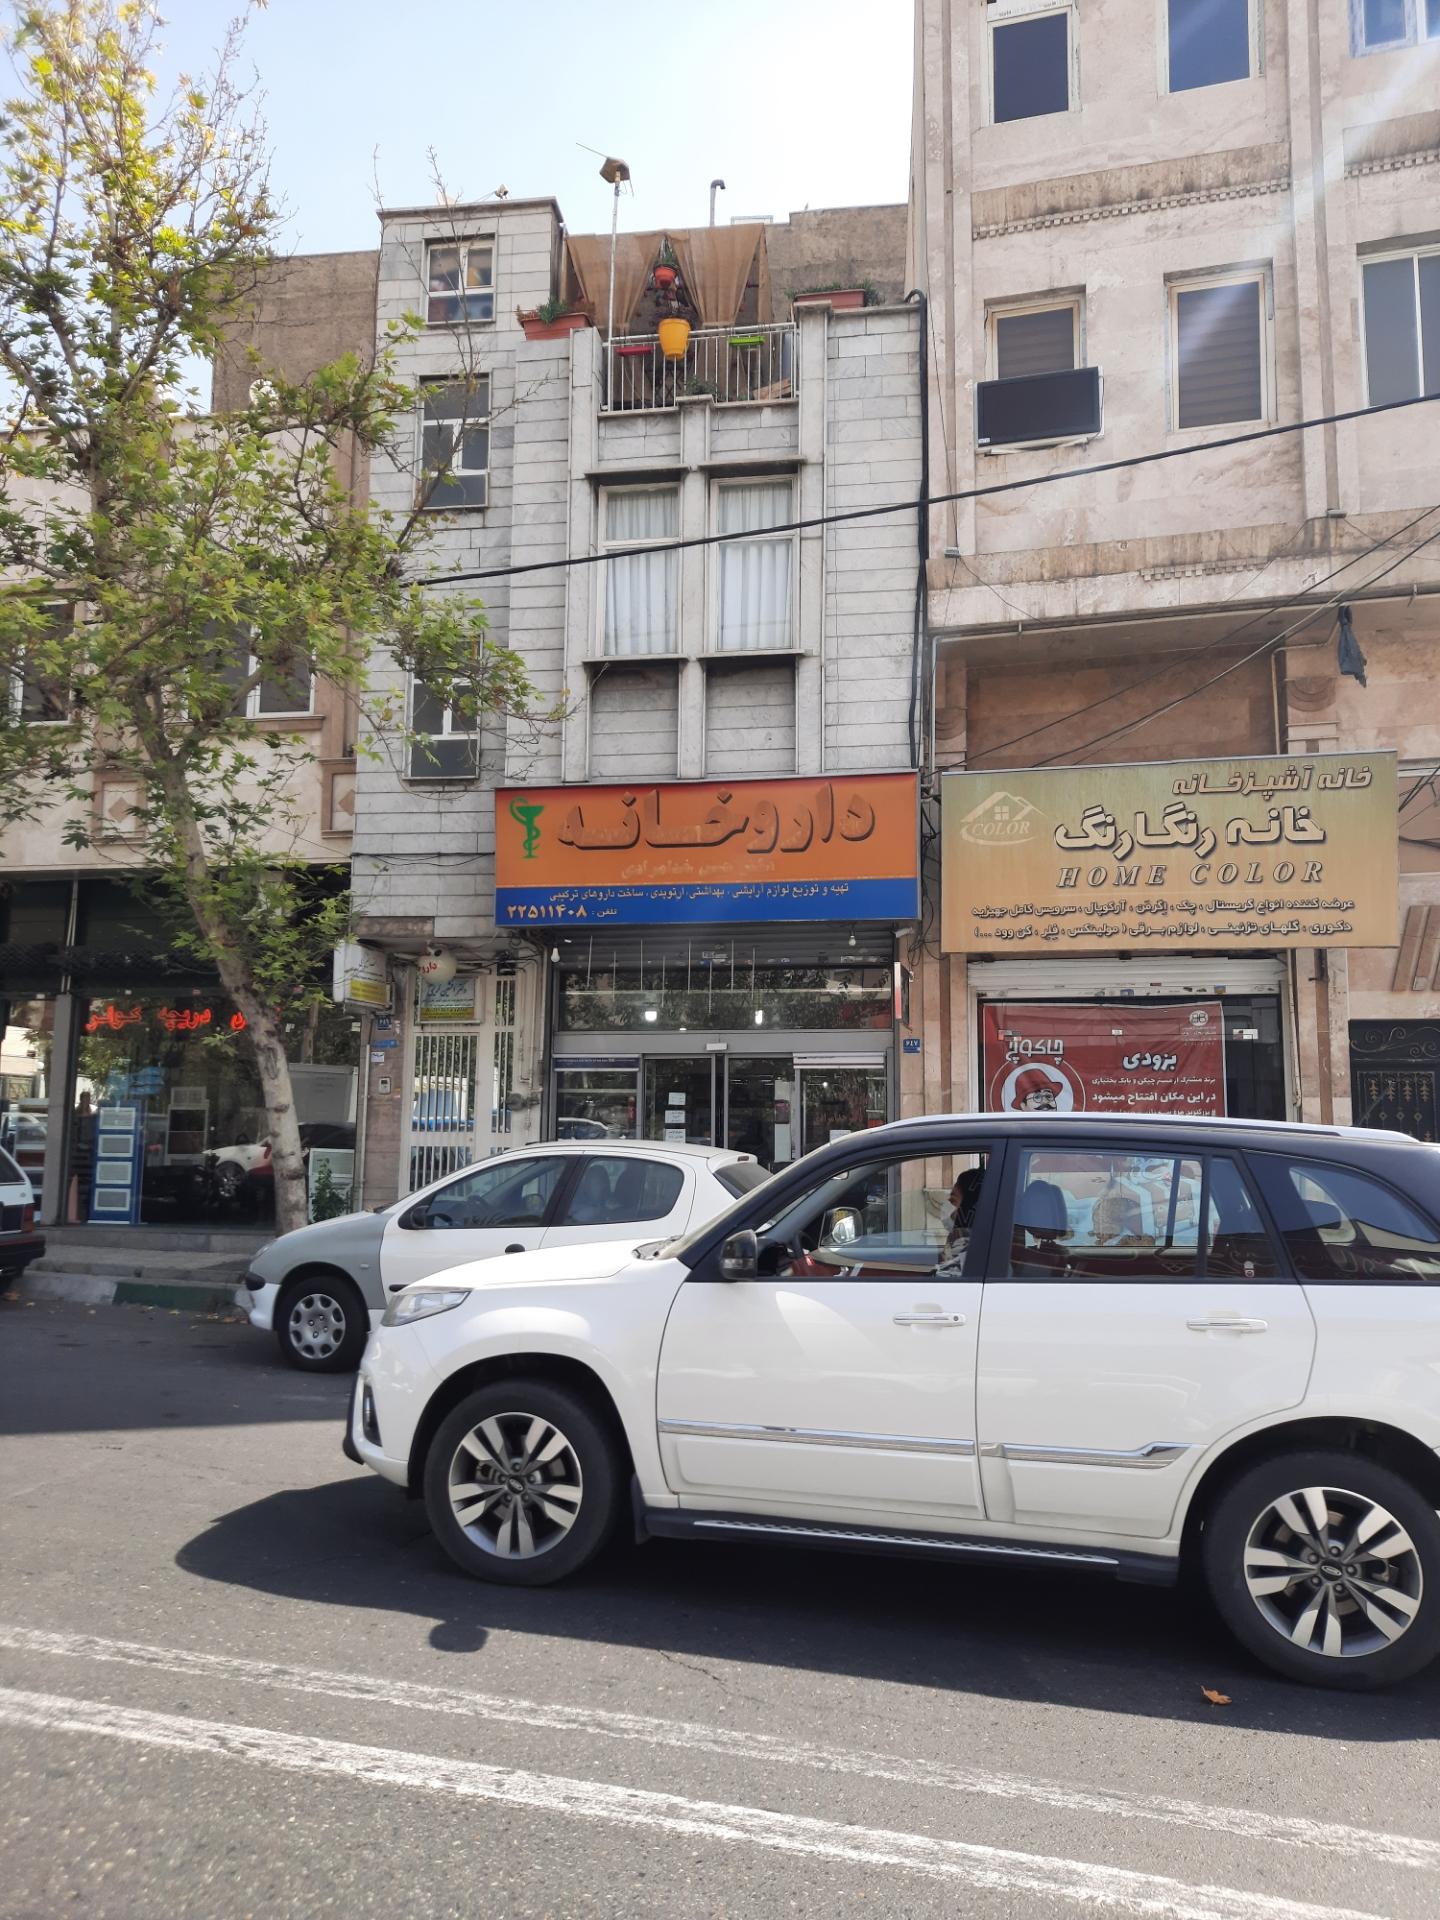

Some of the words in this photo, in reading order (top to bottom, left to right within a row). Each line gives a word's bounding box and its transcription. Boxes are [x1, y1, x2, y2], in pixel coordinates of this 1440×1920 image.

[1172, 764, 1315, 800] آشپزخانه
[1317, 765, 1373, 790] خانه
[557, 780, 876, 854] داروخانه
[972, 820, 1030, 837] COLOR
[1053, 802, 1217, 861] رنگارنگ
[1226, 805, 1327, 845] خانه
[1056, 864, 1167, 889] HOME
[1189, 861, 1324, 885] COLOR
[550, 888, 579, 901] ترکیبی
[581, 887, 615, 900] داروهای
[617, 887, 644, 898] ساخت
[689, 885, 725, 899] بهداشتی
[767, 883, 789, 897] لوازم
[792, 882, 819, 898] توزیع
[822, 885, 828, 896] و
[830, 882, 849, 896] تهیه
[1009, 903, 1033, 917] کامل
[1035, 903, 1077, 917] سرویس
[1085, 899, 1127, 917] آرکوپال
[1176, 900, 1197, 916] چک
[1206, 898, 1255, 914] کریستال
[1256, 899, 1284, 915] انواع
[1286, 897, 1319, 910] کننده
[1320, 898, 1355, 912] عرضه
[972, 904, 1008, 918] جهیزیه
[995, 928, 1014, 940] وود
[1015, 925, 1032, 939] کن
[1129, 923, 1165, 937] برقی
[1167, 922, 1199, 936] لوازم
[1208, 922, 1257, 936] تزئینی
[1259, 919, 1300, 936] گلهای
[1309, 920, 1352, 935] دکوری
[1123, 1052, 1177, 1071] بزودی
[1092, 1090, 1126, 1104] میشود
[1128, 1091, 1158, 1106] افتتاح
[1160, 1091, 1185, 1104] مکان
[1187, 1091, 1204, 1104] این
[1205, 1093, 1216, 1104] در
